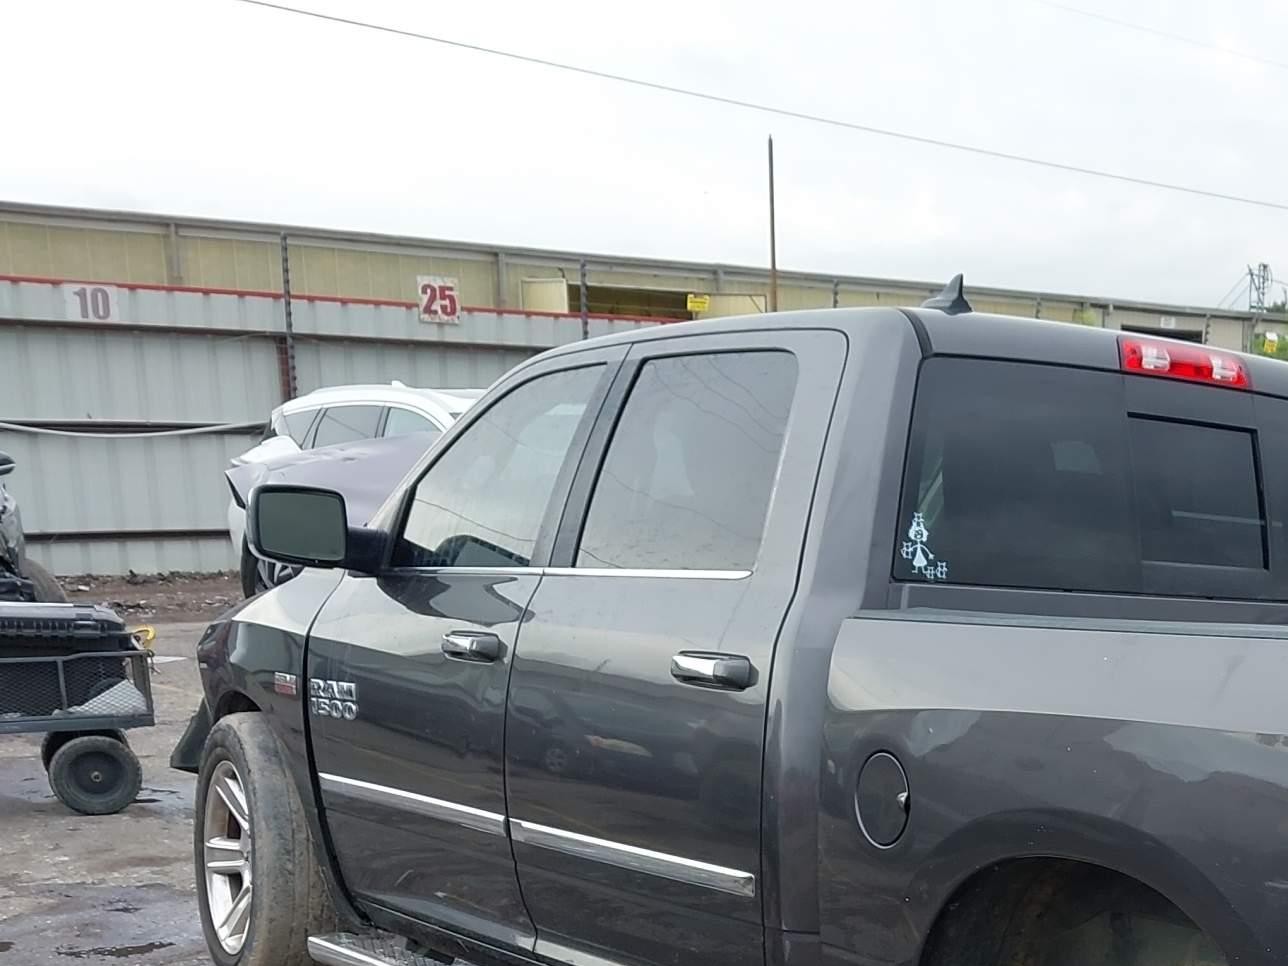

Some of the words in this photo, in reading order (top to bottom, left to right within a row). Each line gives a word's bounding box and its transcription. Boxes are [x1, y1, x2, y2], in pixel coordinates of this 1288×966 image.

[73, 286, 111, 320] 10
[421, 283, 457, 317] 25
[310, 678, 356, 701] RAM
[310, 697, 358, 720] 1500
